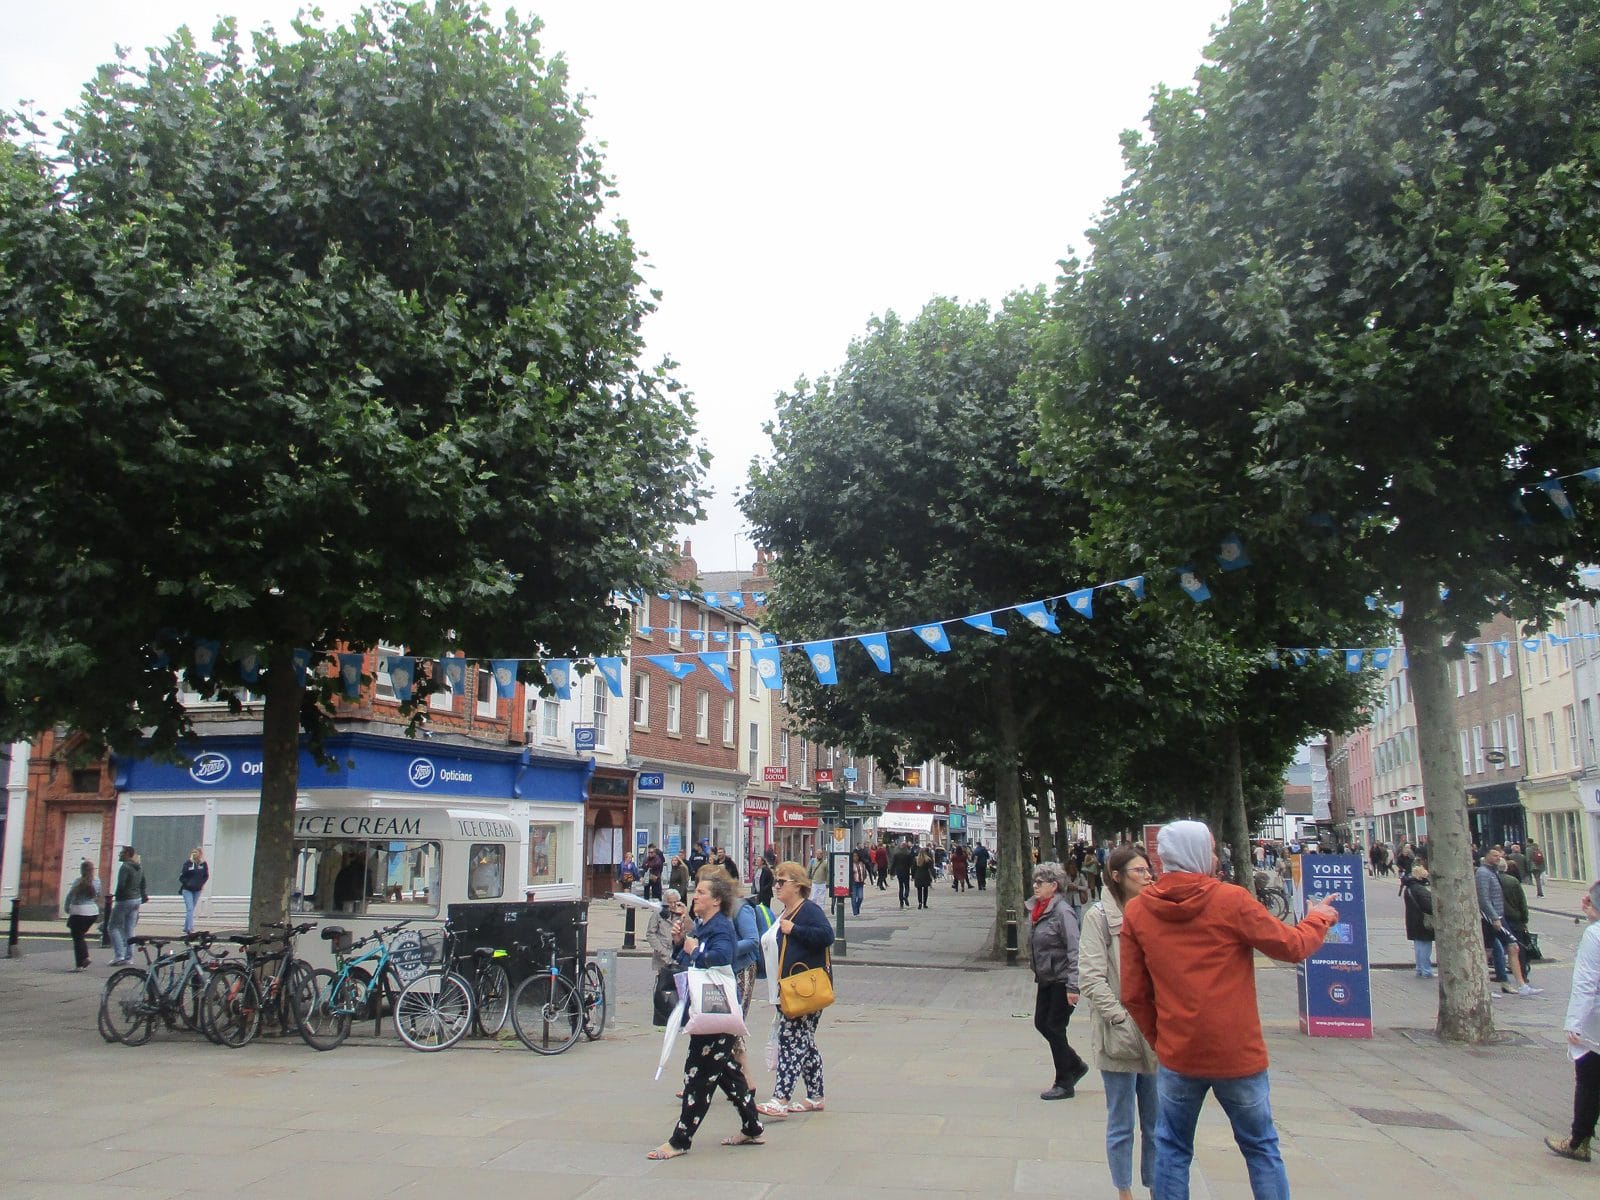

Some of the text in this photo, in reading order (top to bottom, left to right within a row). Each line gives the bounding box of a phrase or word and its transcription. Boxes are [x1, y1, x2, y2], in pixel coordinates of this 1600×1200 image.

[440, 768, 473, 782] Opticians
[298, 816, 421, 835] ICE CREAM
[458, 820, 514, 838] ICE CREAM
[1312, 865, 1352, 874] YORK
[1313, 880, 1353, 890] GIFT
